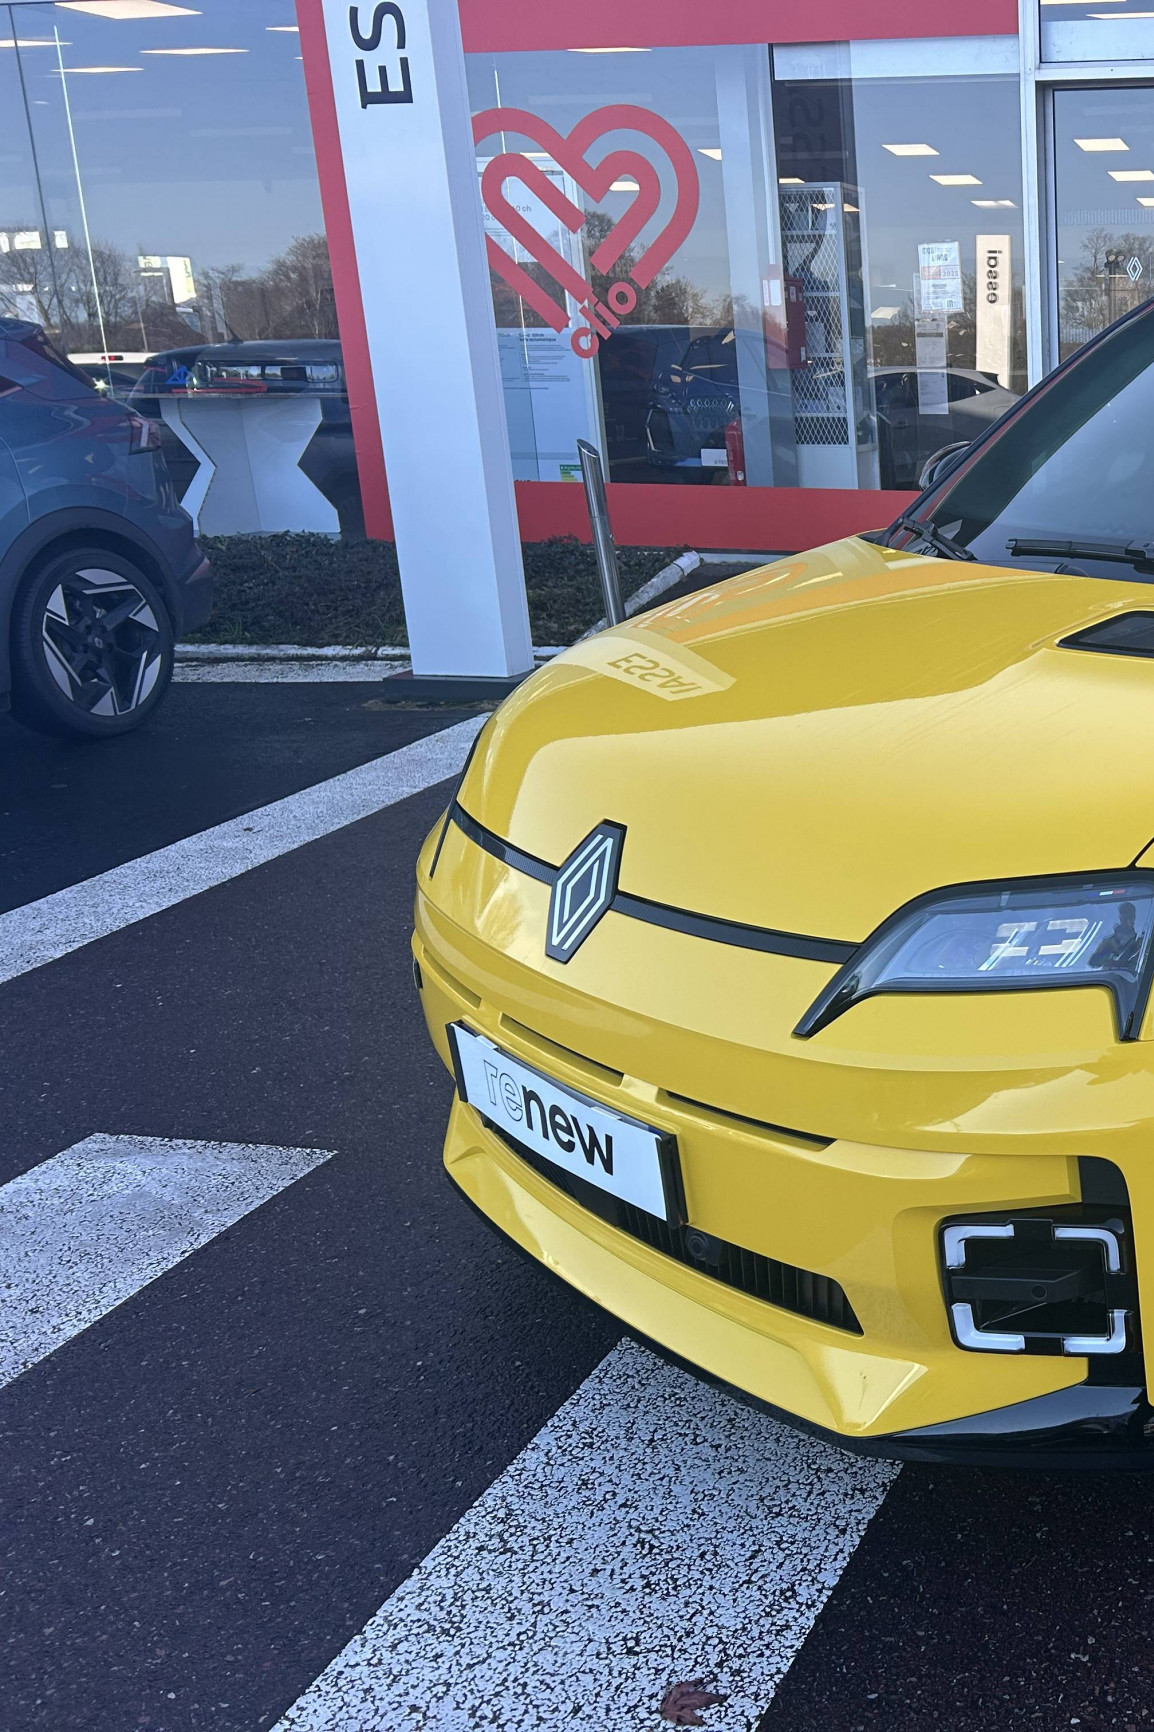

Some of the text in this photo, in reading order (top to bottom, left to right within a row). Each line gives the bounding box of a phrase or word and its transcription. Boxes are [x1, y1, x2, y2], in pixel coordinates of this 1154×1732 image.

[349, 1, 413, 109] ES
[571, 281, 637, 359] clio
[483, 1059, 613, 1176] renew
